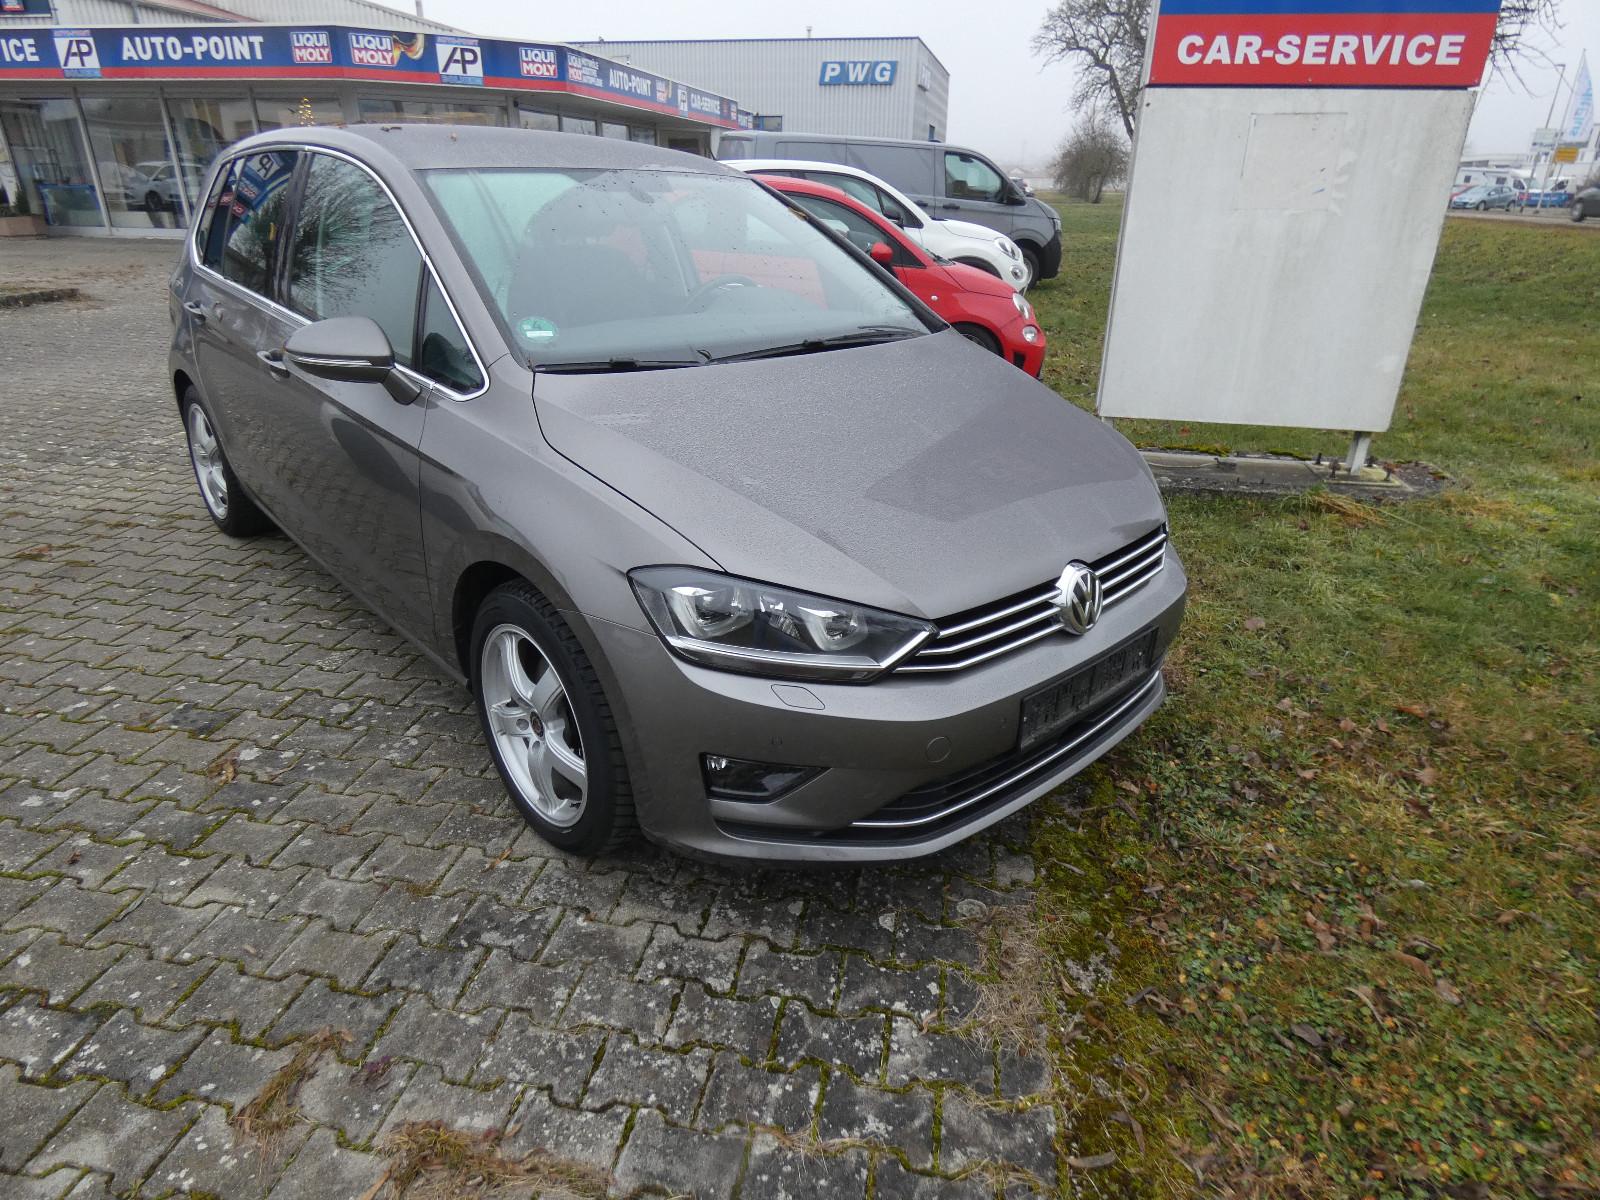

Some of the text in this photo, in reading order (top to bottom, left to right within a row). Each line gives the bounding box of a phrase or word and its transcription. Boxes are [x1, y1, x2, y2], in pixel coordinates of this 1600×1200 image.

[121, 35, 264, 61] AUTO-POINT
[292, 33, 328, 47] LIQUI
[351, 34, 392, 51] LIQUI
[294, 48, 330, 62] MOLY
[353, 50, 394, 65] MOLY
[520, 49, 556, 64] LIQUI
[1176, 34, 1466, 66] CAR-SERVICE
[441, 46, 479, 75] AP
[522, 63, 557, 76] MOLY
[609, 68, 652, 97] AUTO-POINT
